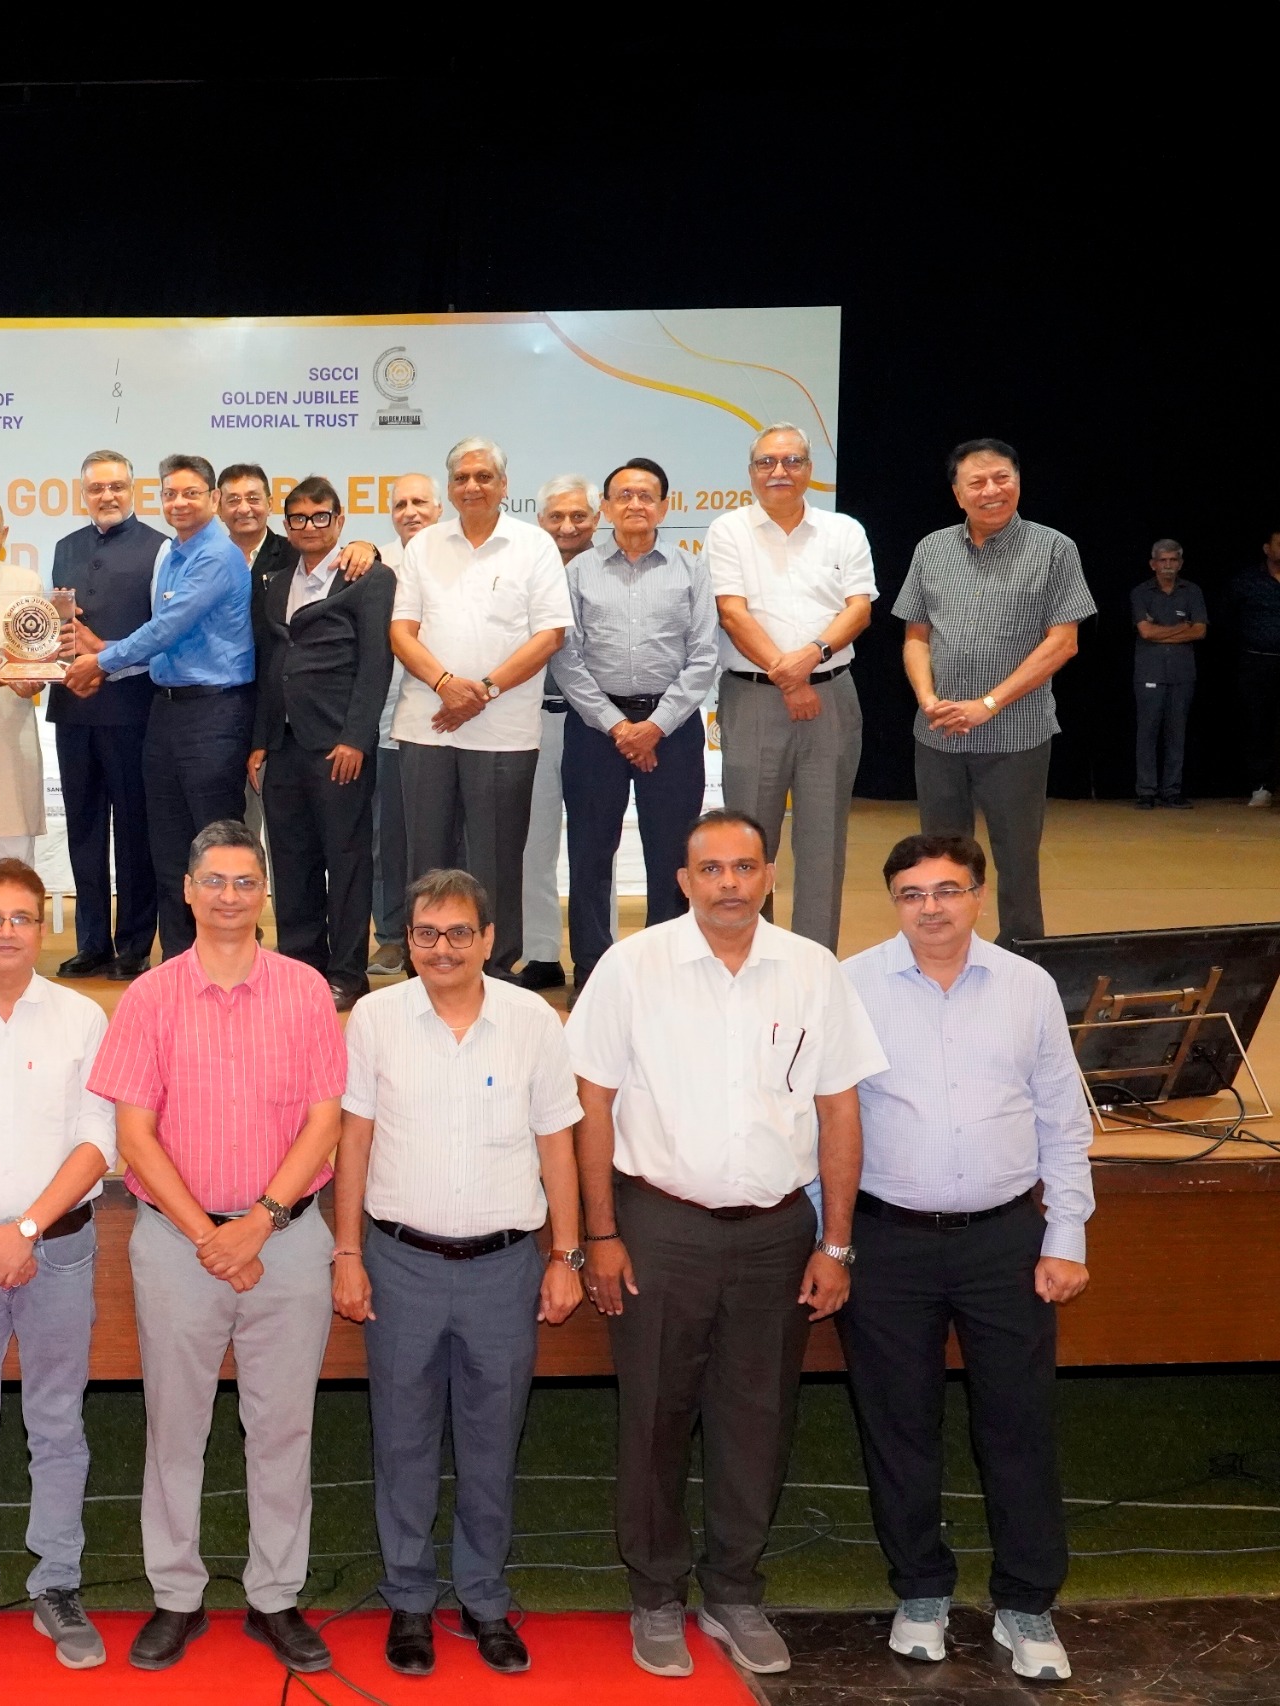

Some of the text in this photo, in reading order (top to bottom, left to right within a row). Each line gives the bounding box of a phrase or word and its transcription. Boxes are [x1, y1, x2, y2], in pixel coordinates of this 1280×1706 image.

[309, 366, 359, 381] SGCCI
[112, 382, 122, 397] &
[222, 390, 359, 405] GOLDEN JUBILEE
[211, 413, 359, 428] MEMORIAL TRUST
[695, 490, 753, 510] 2026
